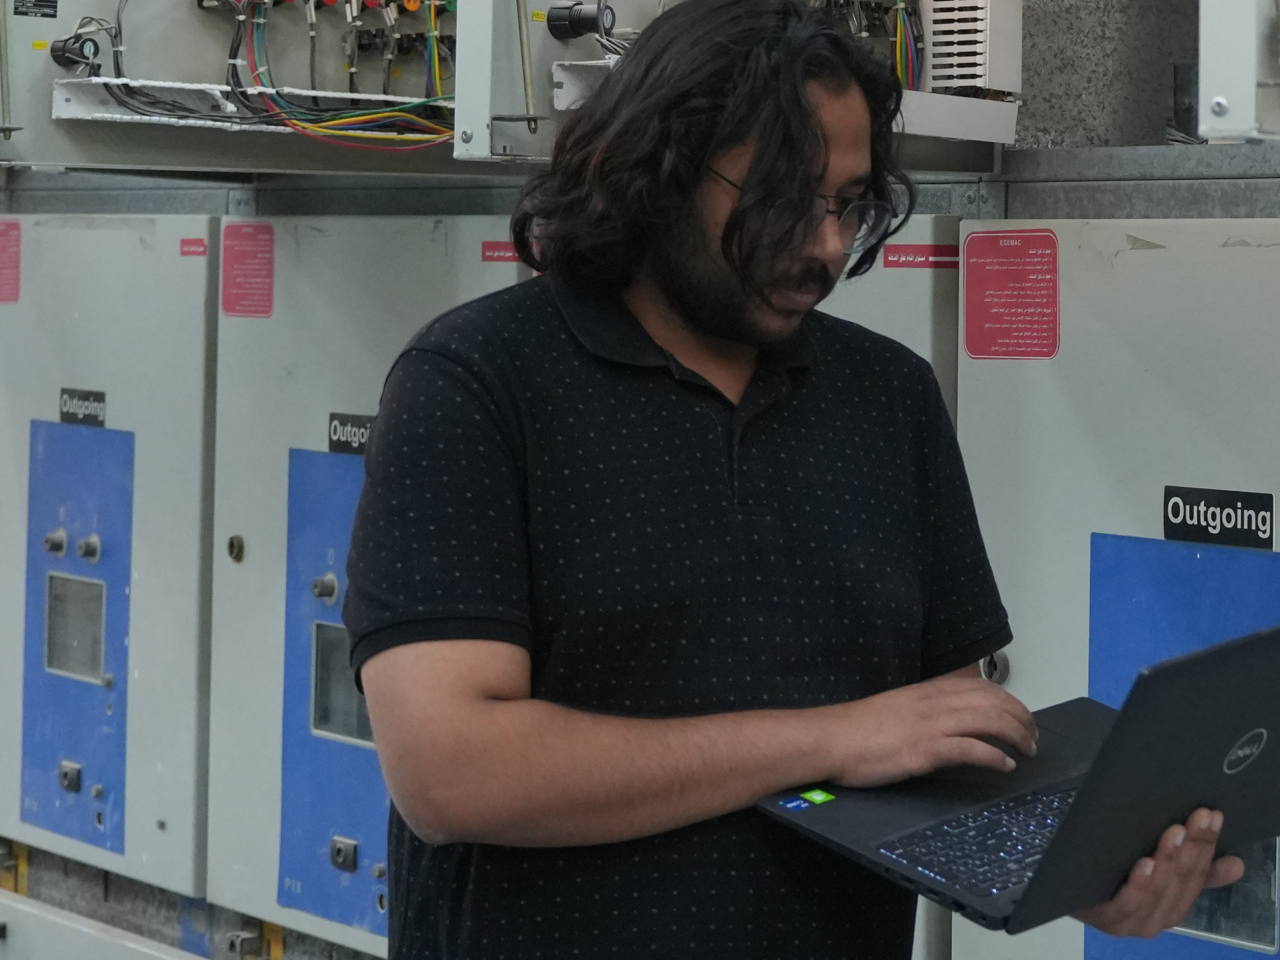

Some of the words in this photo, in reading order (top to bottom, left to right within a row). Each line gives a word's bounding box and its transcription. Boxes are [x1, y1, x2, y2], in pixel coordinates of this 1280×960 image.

[61, 393, 105, 421] Outgoing
[330, 419, 371, 448] Outgoi
[1167, 496, 1271, 539] Outgoing
